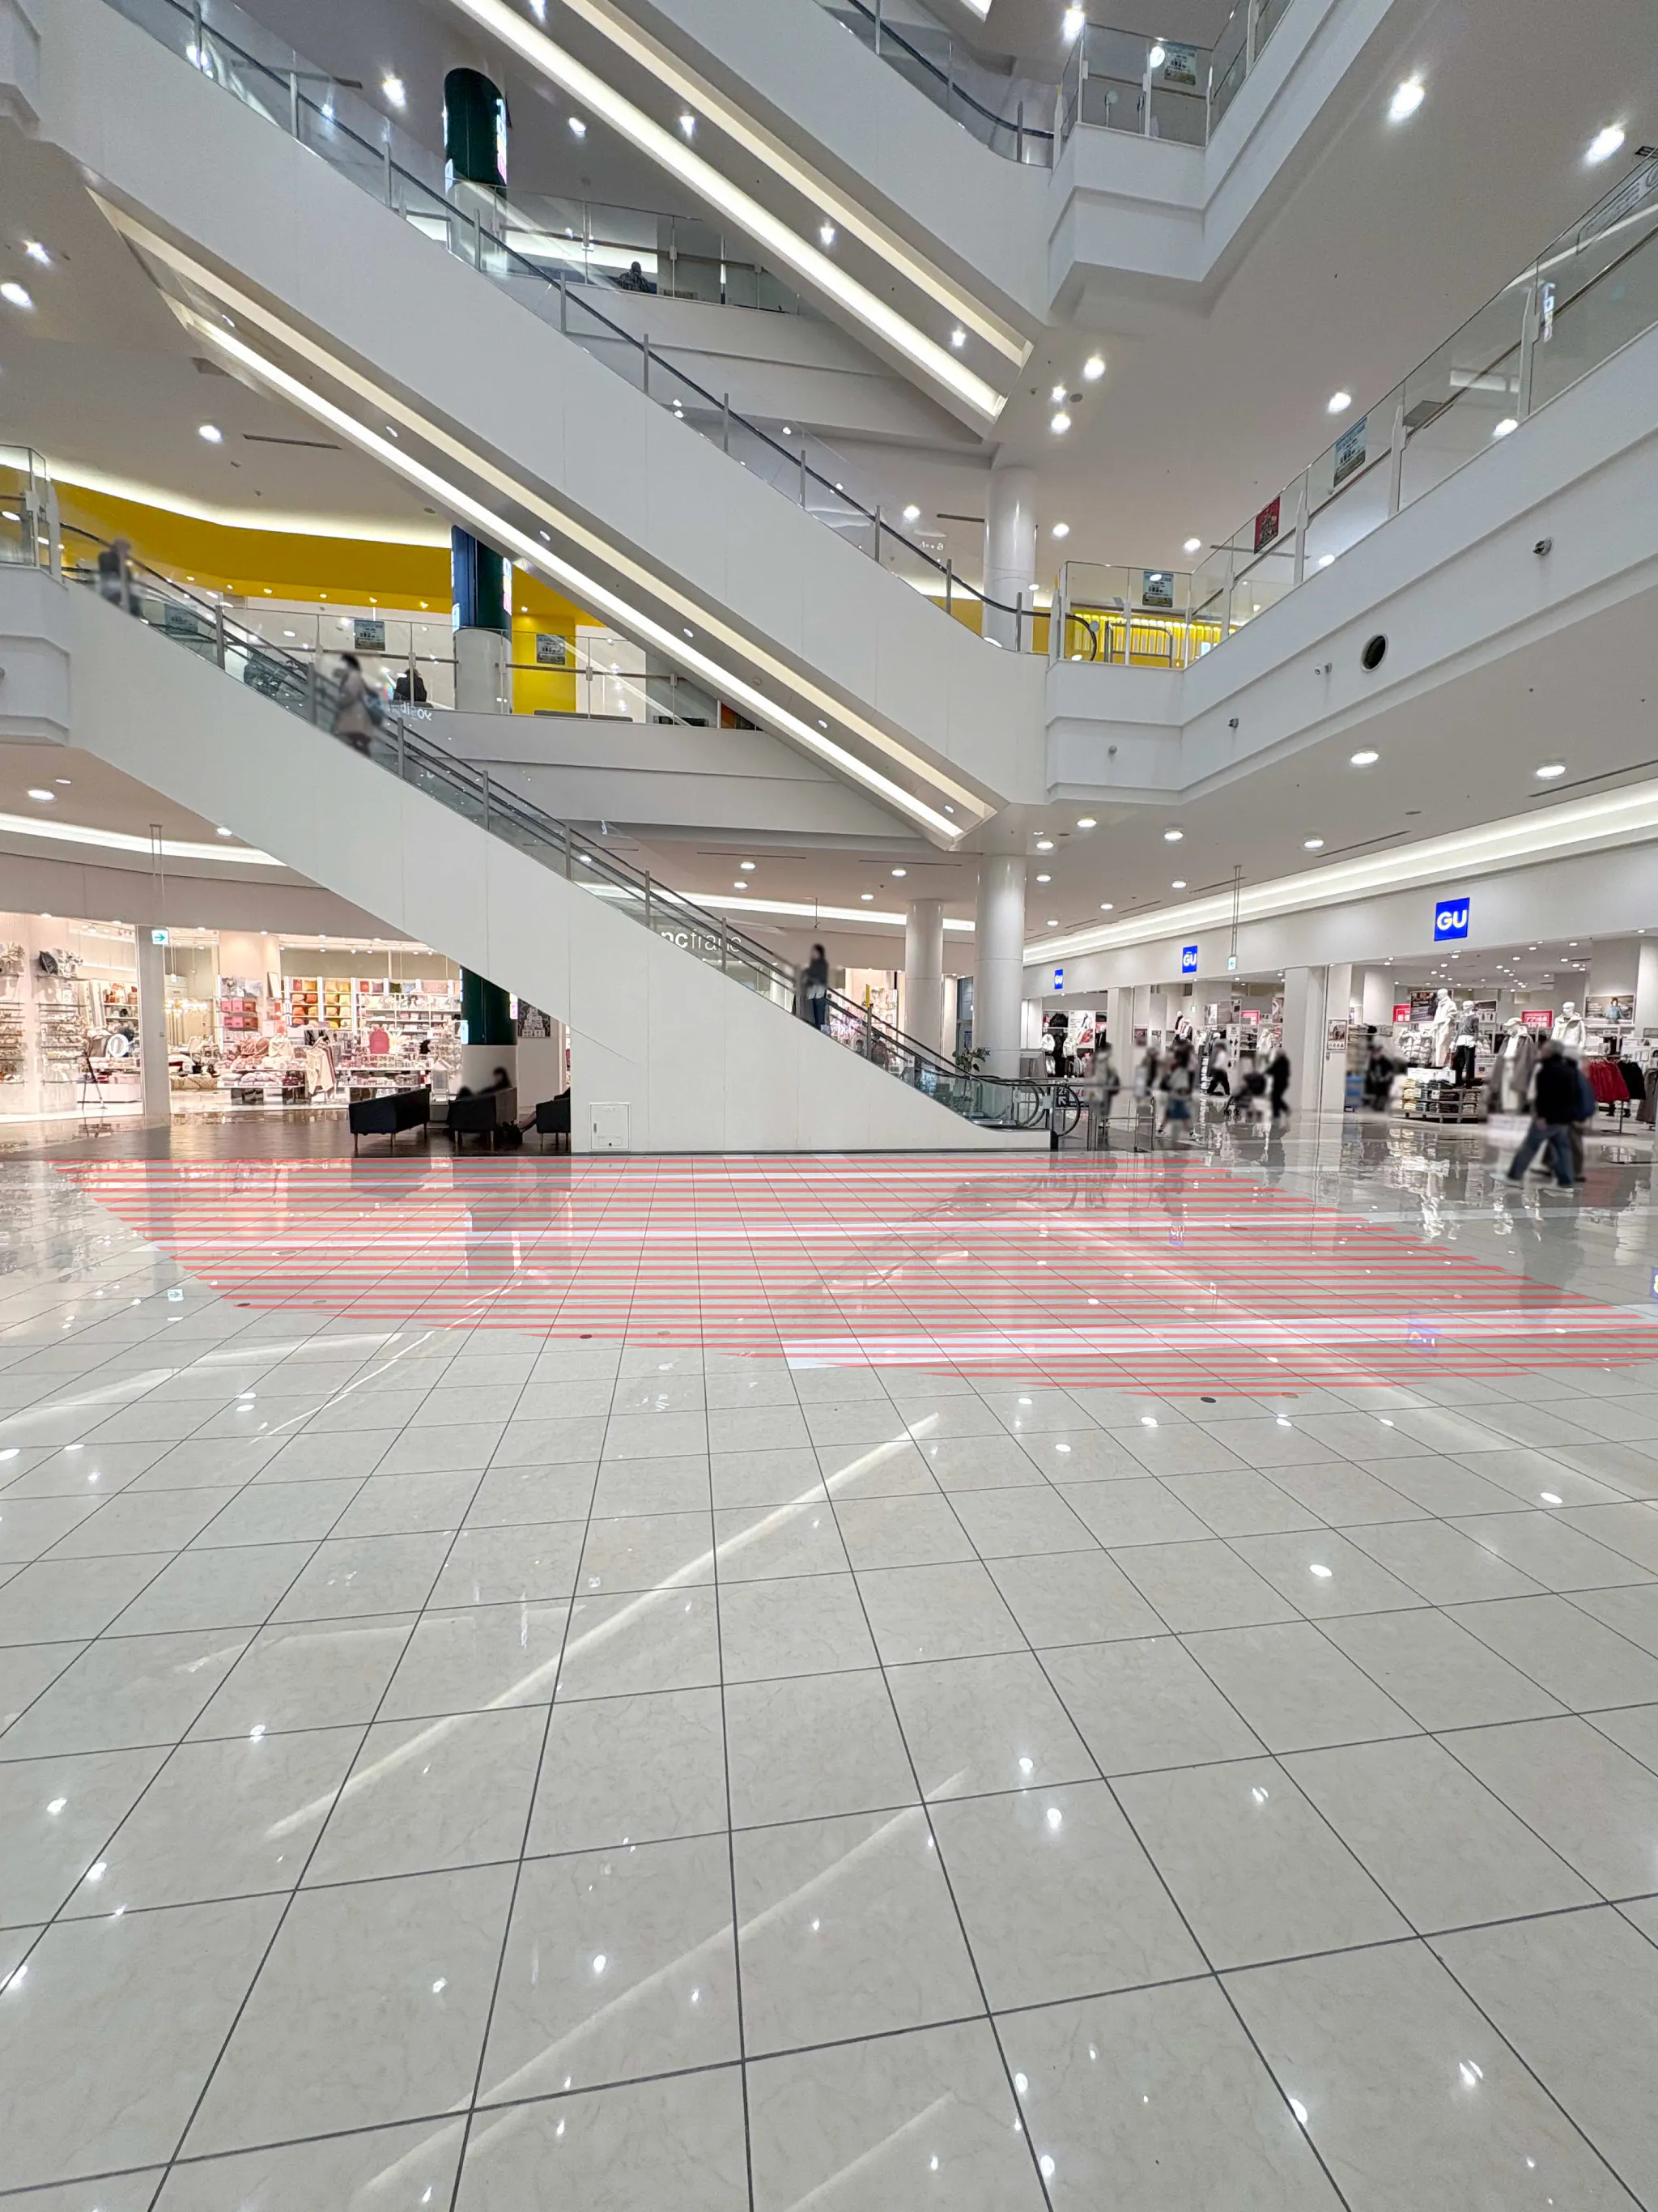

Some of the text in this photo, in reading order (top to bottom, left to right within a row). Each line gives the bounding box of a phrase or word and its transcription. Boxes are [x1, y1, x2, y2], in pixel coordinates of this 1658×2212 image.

[1437, 909, 1468, 930] GU
[1183, 953, 1197, 967] GU
[1054, 975, 1063, 985] GU
